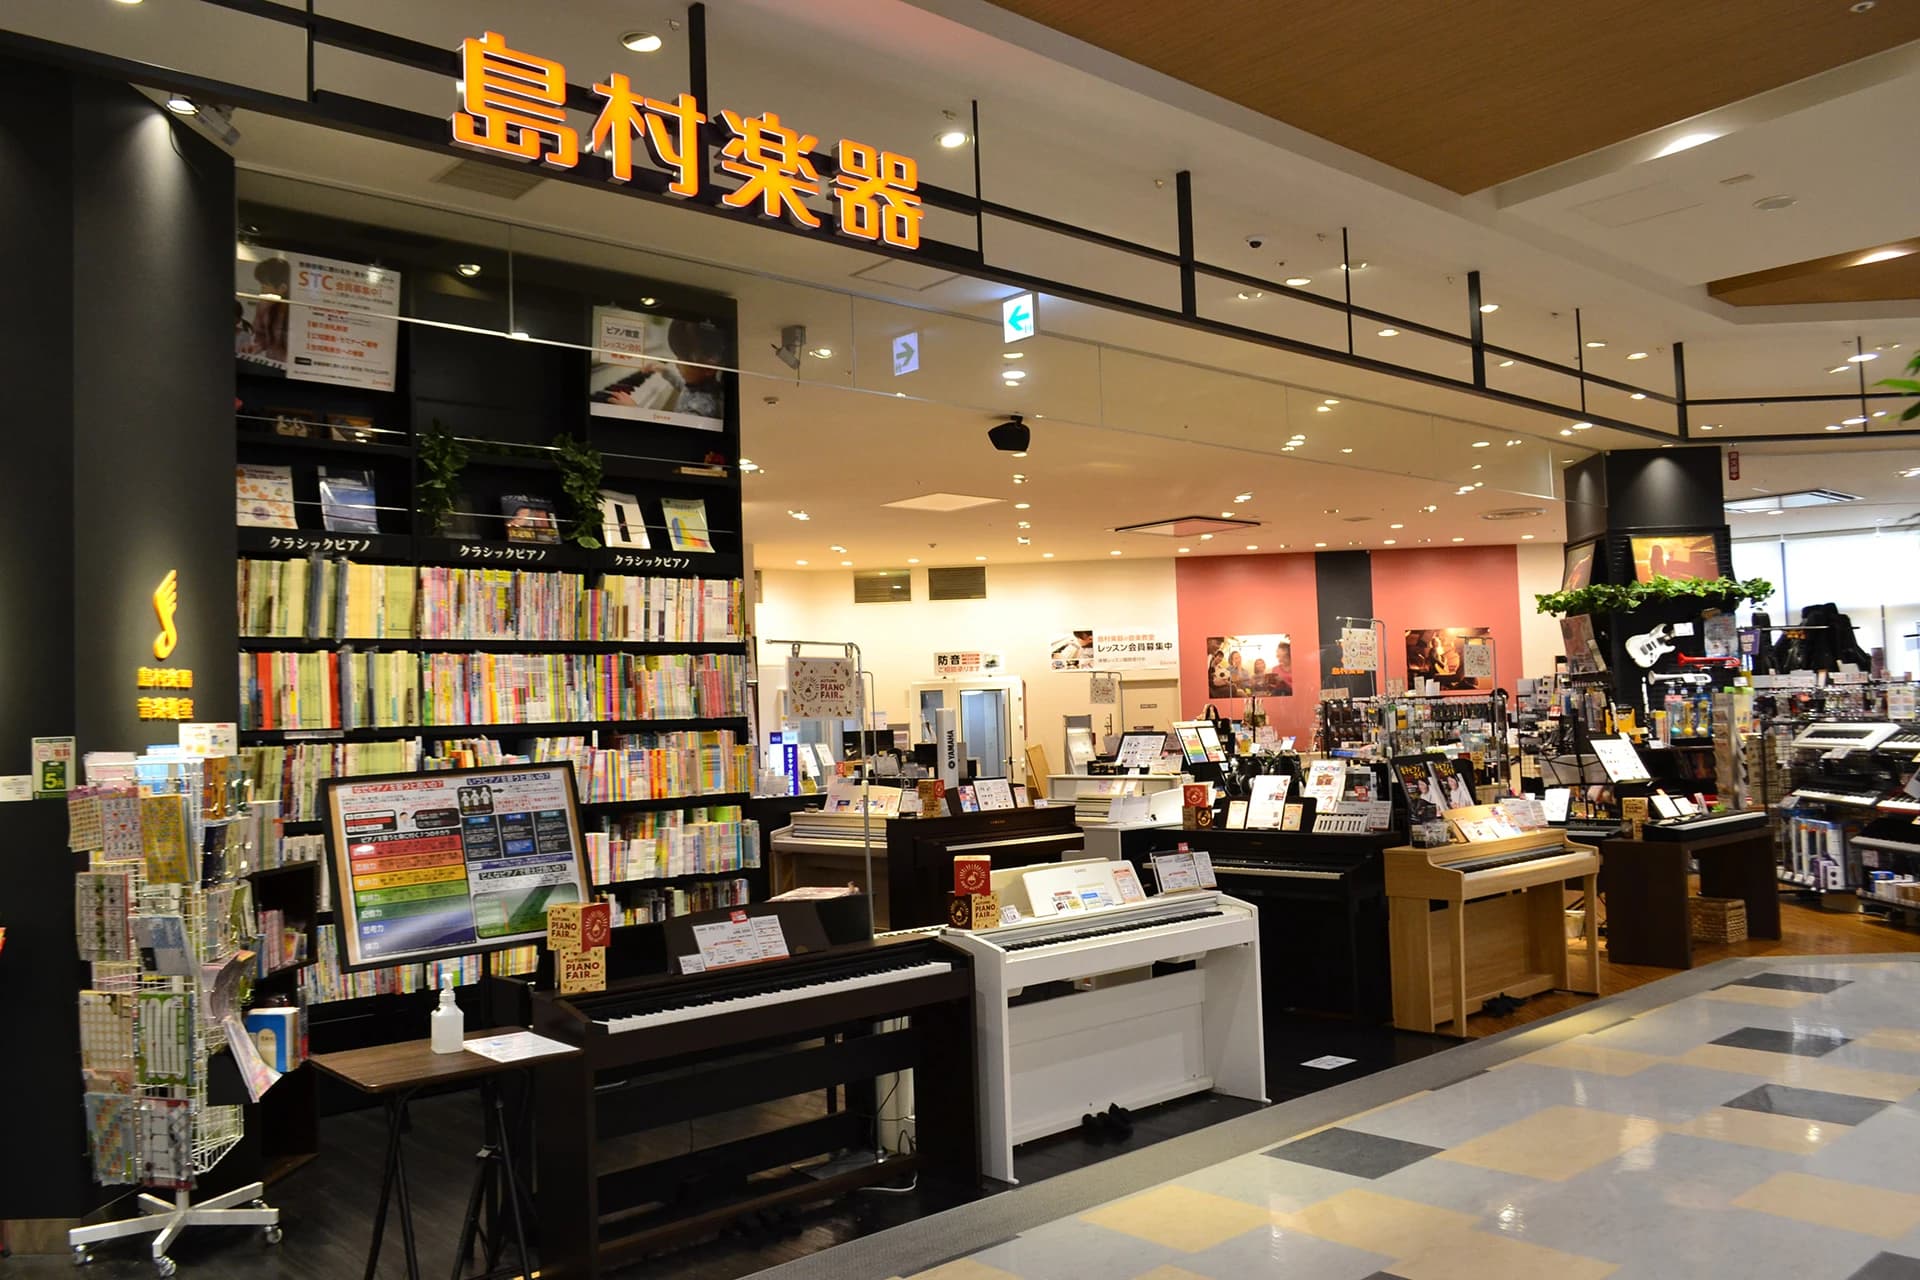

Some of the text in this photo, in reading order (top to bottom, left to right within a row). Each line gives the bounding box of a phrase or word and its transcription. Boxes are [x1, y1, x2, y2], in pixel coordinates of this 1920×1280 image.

[451, 30, 925, 251] 島村楽器
[298, 271, 334, 291] STC
[269, 536, 371, 552] クラシックピアノ
[460, 545, 547, 561] クラシックピアノ
[614, 554, 690, 570] クラシックピアノ
[1097, 642, 1173, 653] レッスン会員募集中
[937, 654, 961, 666] 防音
[946, 729, 955, 760] YAMAHA
[975, 904, 996, 912] PIANO
[975, 911, 991, 919] FAIR
[551, 921, 577, 931] PIANO
[551, 930, 570, 938] FAIR
[566, 961, 600, 972] PIANO
[566, 970, 591, 980] FAIR
